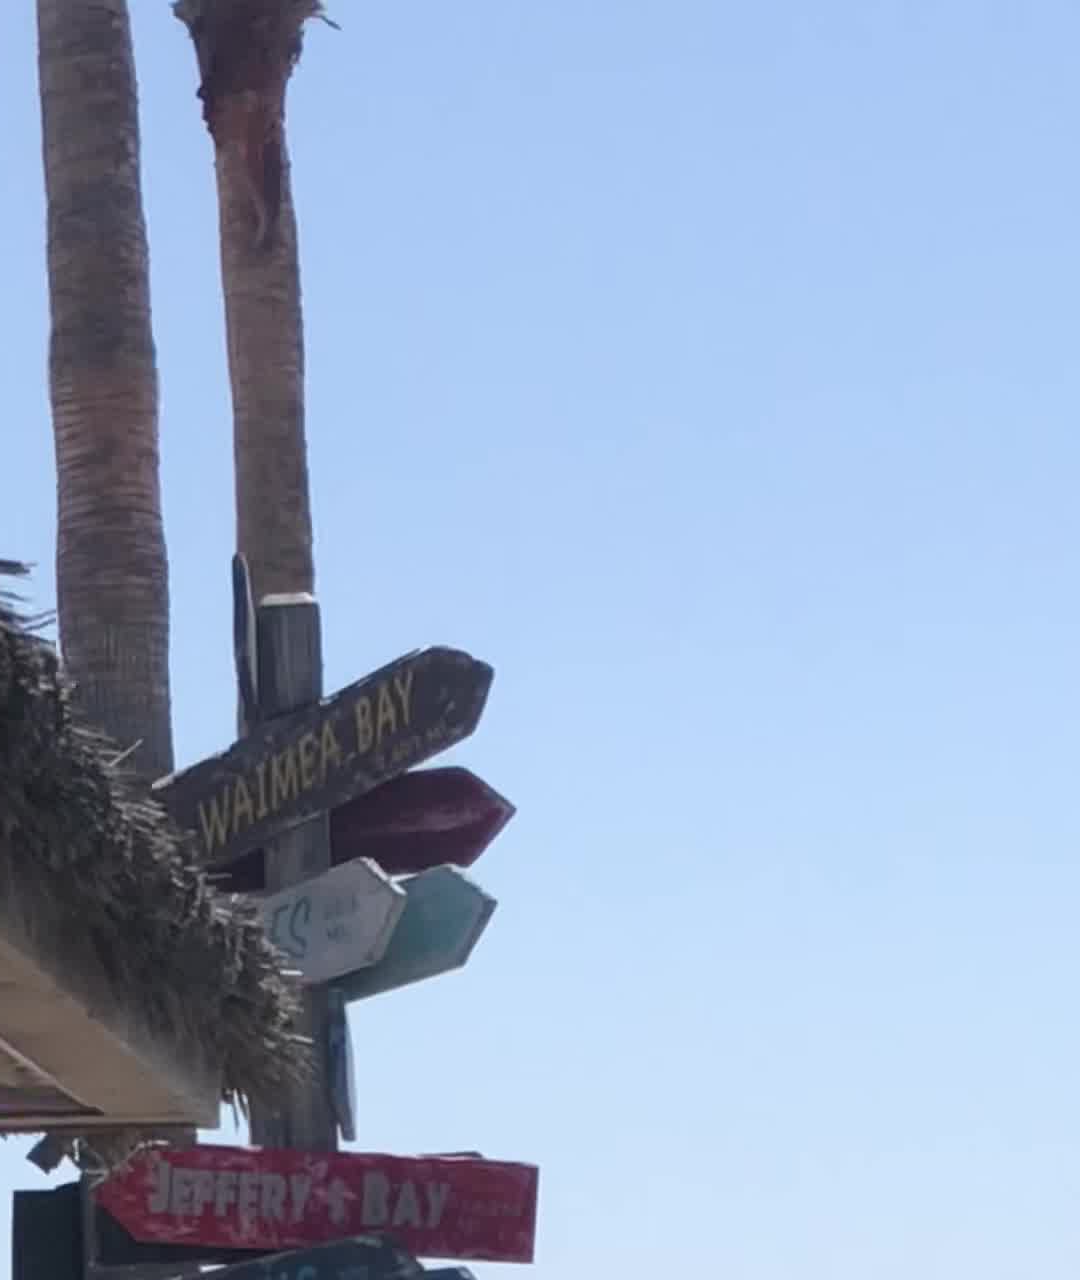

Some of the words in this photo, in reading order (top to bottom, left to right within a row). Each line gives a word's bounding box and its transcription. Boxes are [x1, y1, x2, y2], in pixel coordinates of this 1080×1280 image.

[198, 717, 342, 850] WAIMEA
[353, 666, 415, 753] BAY
[361, 1170, 451, 1228] BAY
